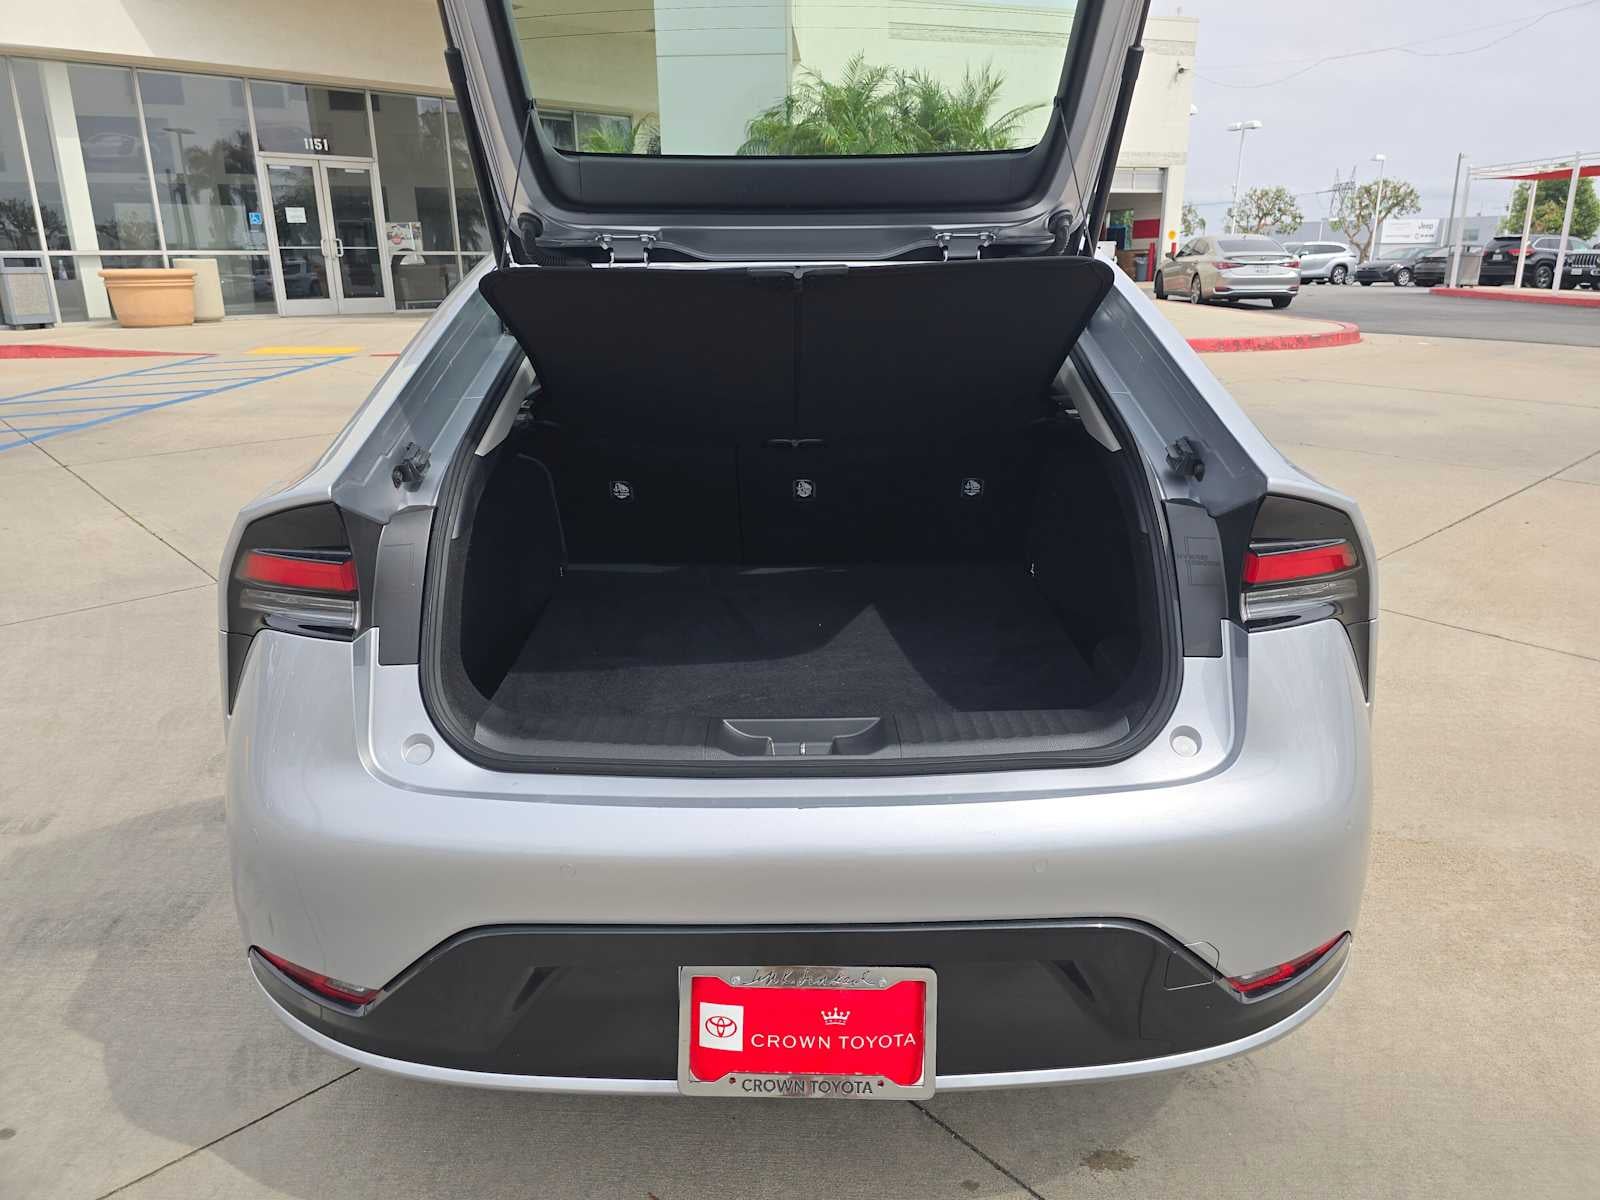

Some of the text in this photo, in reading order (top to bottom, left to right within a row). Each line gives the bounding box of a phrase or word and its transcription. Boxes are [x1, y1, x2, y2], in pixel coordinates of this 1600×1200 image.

[303, 137, 329, 152] 1151
[750, 1032, 917, 1050] CROWN TOYOTA
[741, 1078, 873, 1095] CROWN TOYOTA
